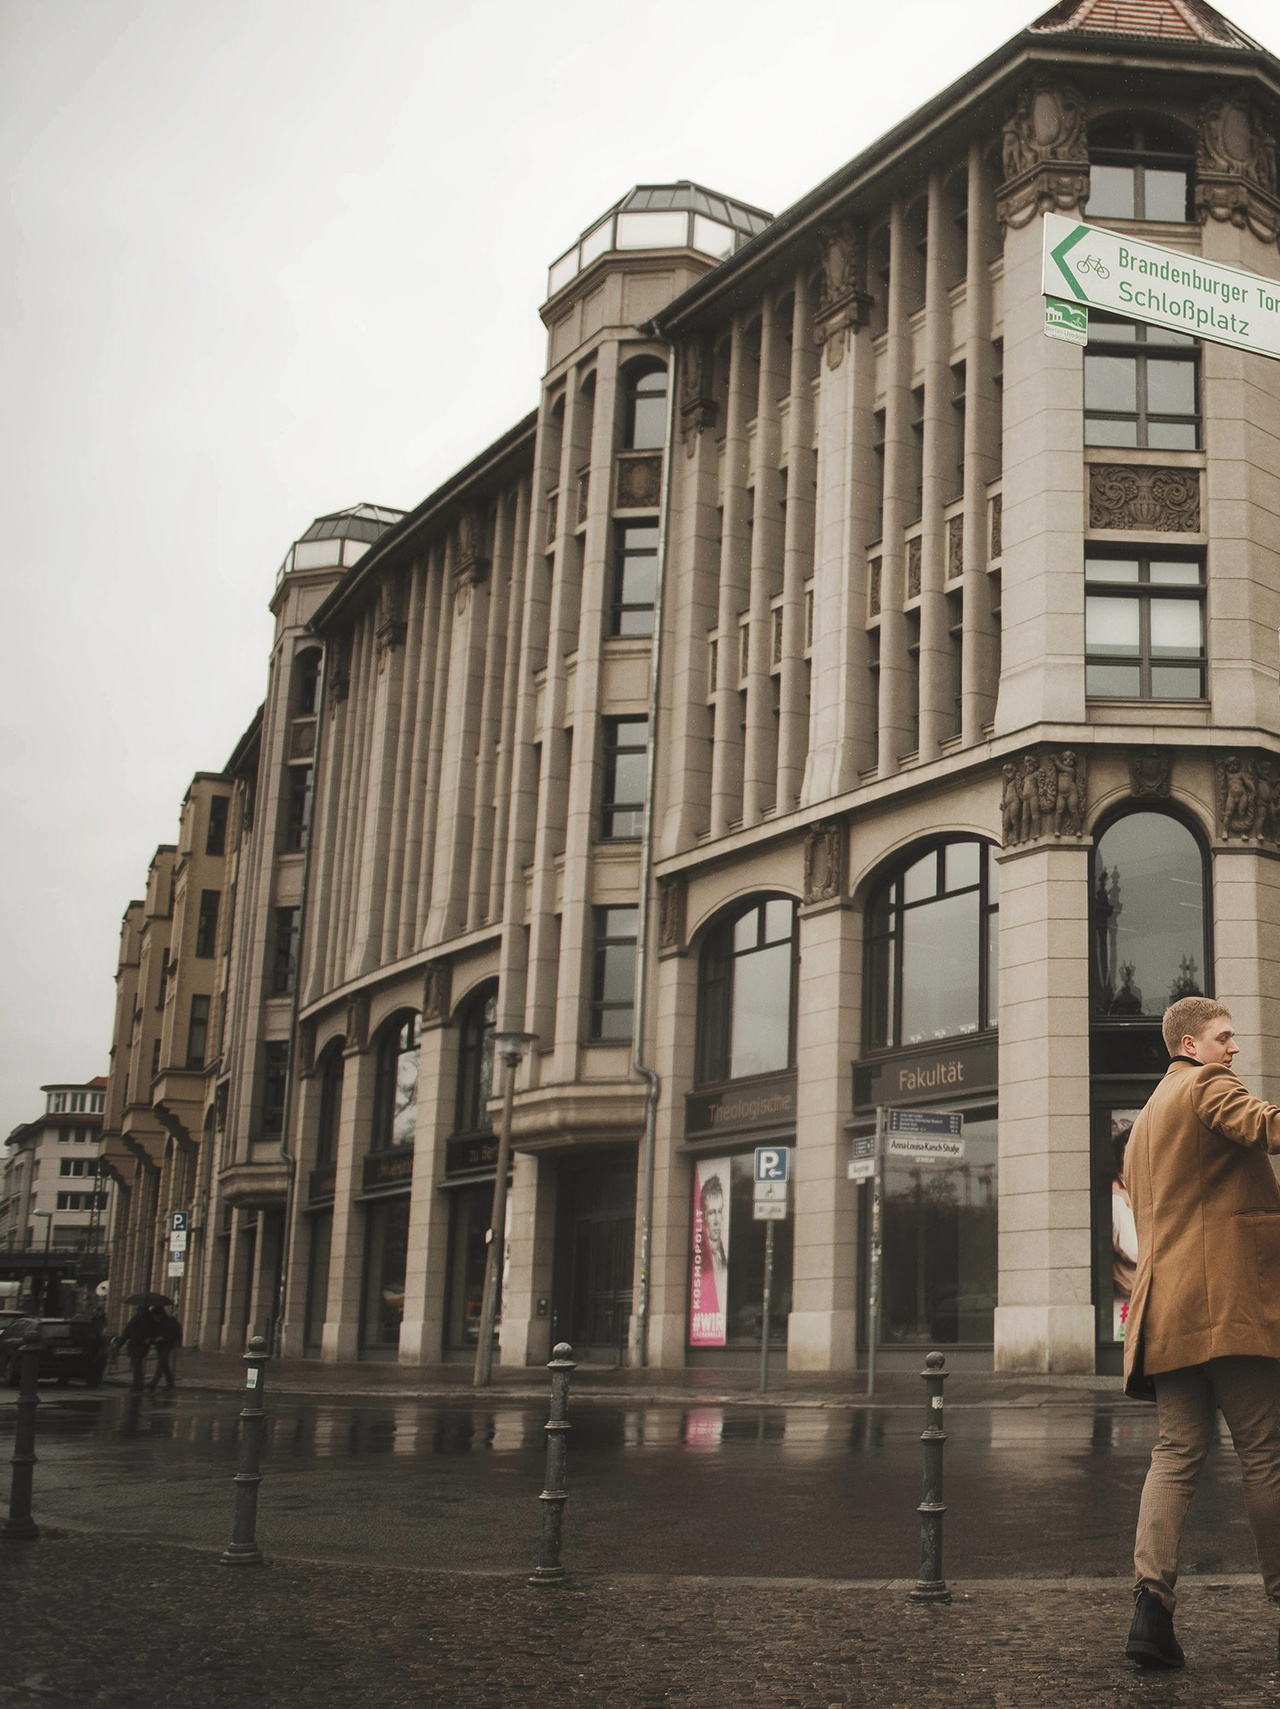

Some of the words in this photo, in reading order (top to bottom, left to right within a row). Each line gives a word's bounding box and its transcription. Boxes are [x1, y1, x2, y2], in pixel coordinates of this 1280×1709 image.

[1119, 247, 1248, 303] Brandenburger
[1257, 288, 1280, 313] Tor
[1119, 281, 1249, 336] Schloßplatz
[899, 1060, 964, 1091] Fakultät
[708, 1093, 792, 1123] Theologische
[759, 1151, 780, 1179] P
[172, 1214, 183, 1230] P
[693, 1210, 703, 1309] KOSMOPOLIT
